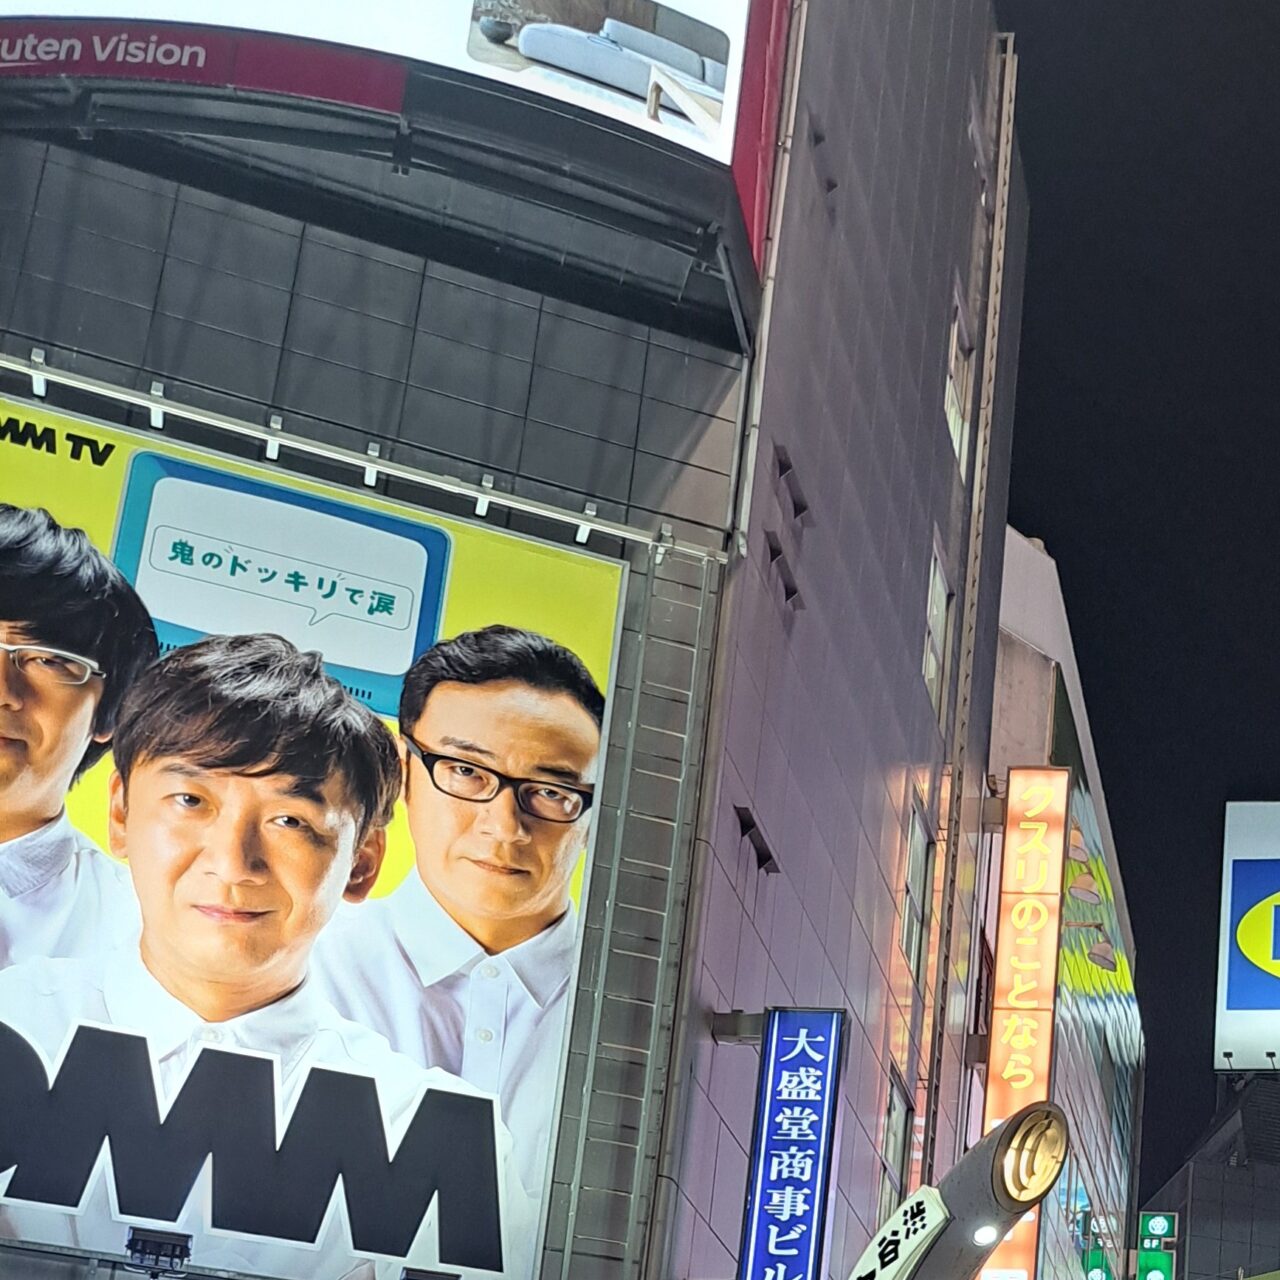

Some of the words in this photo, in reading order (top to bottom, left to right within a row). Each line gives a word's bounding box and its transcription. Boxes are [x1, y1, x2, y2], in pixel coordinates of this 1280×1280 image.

[0, 34, 82, 61] uten
[92, 33, 206, 67] Vision
[65, 432, 116, 467] TV
[168, 538, 396, 616] 鬼のドッキリで涙
[1000, 785, 1054, 1089] クスリのことなら
